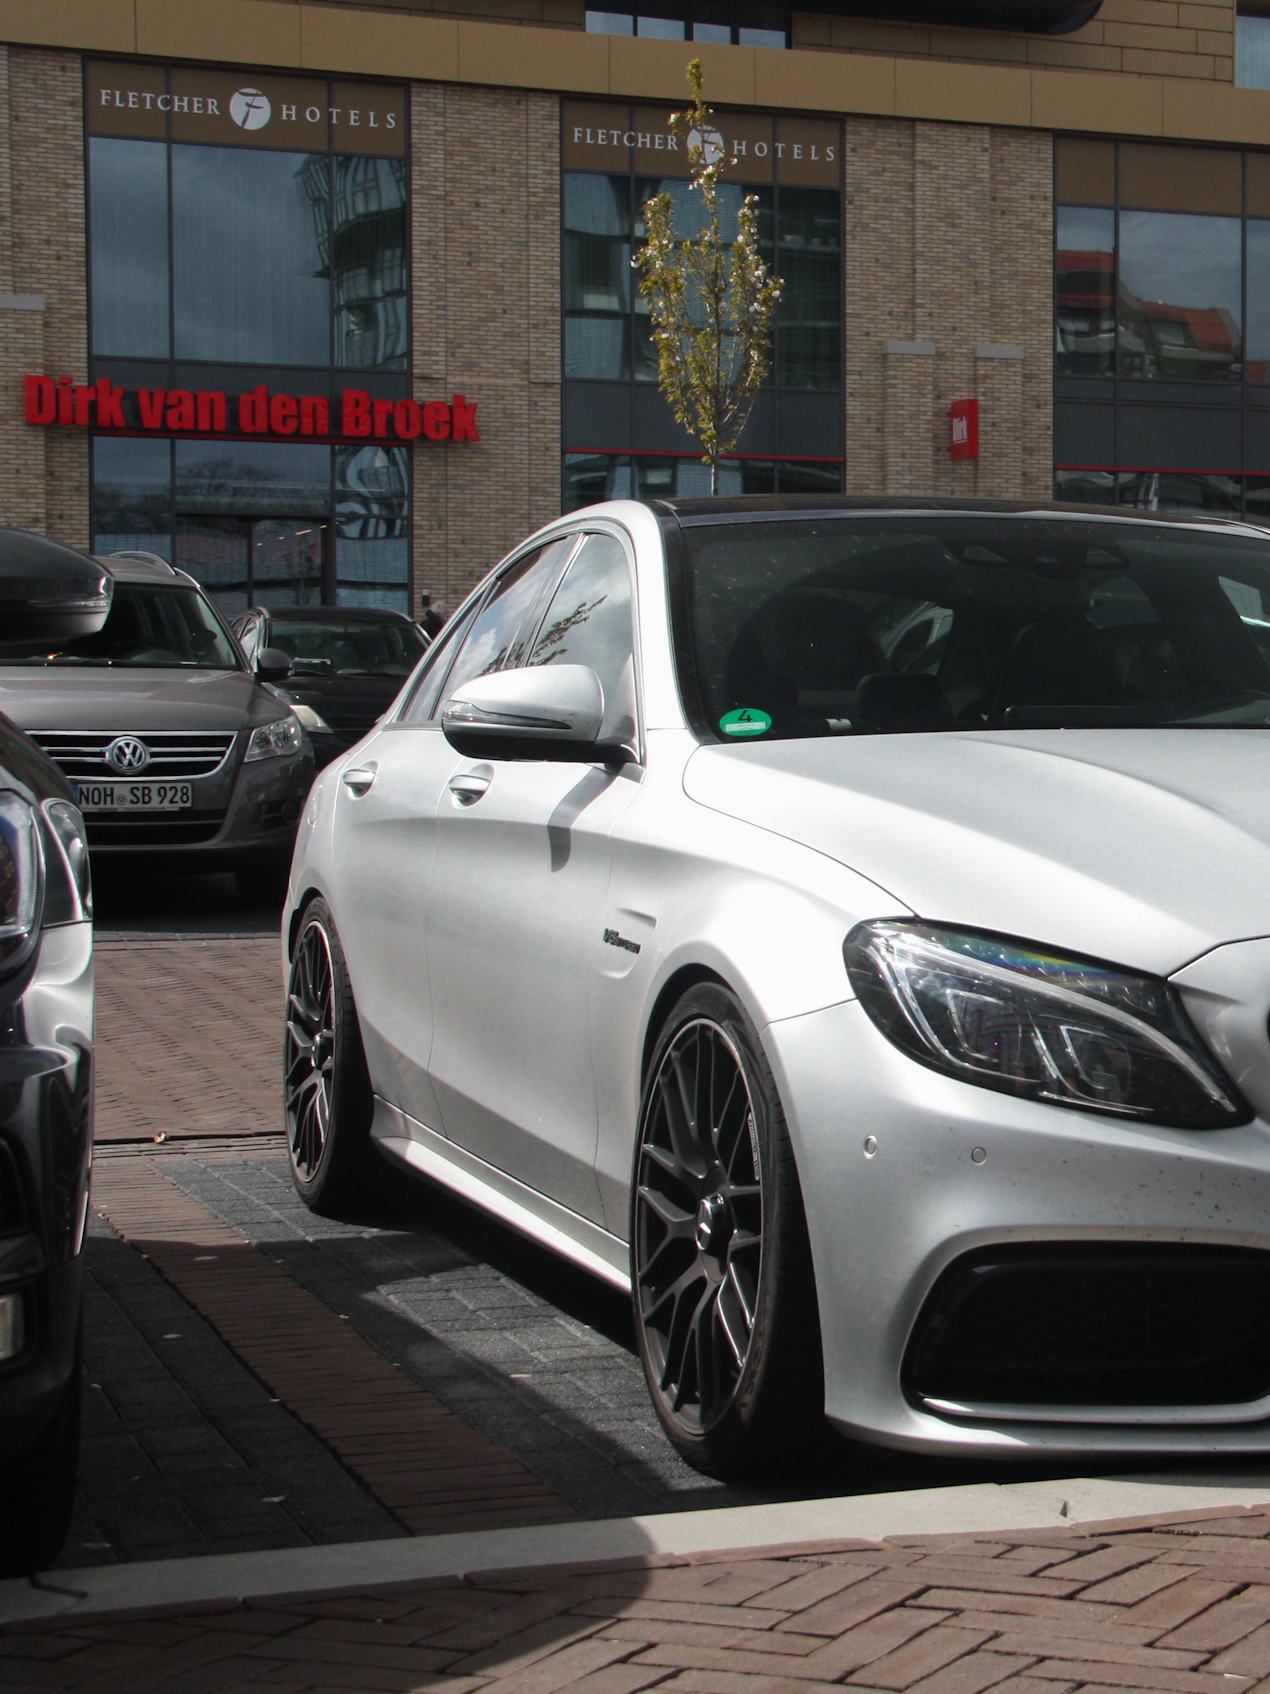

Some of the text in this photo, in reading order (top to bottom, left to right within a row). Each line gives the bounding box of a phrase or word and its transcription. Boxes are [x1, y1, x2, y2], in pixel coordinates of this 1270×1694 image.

[99, 89, 220, 115] FLETCHER
[281, 104, 396, 129] HOTELS
[572, 127, 679, 150] FLETCHER
[732, 140, 835, 162] HOTELS
[24, 374, 480, 442] Dirk van den Broek
[737, 709, 753, 723] 4
[79, 786, 190, 805] NOH SB 928
